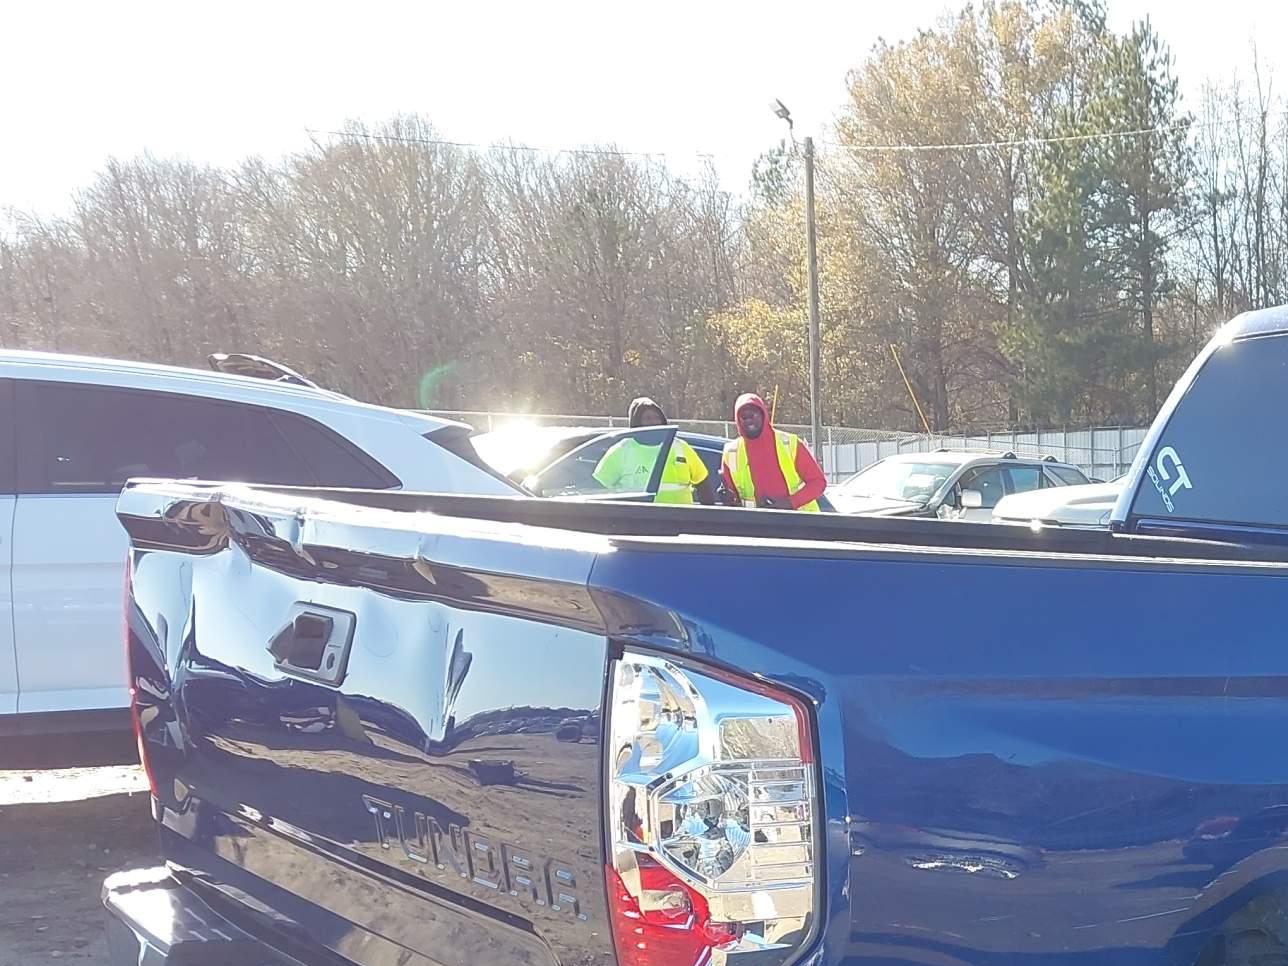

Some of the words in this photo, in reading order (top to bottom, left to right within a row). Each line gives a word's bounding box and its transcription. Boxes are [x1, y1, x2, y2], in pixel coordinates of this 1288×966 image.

[1146, 465, 1175, 513] SOUNDS
[1157, 446, 1193, 496] CT
[362, 793, 588, 921] TUNDRA
